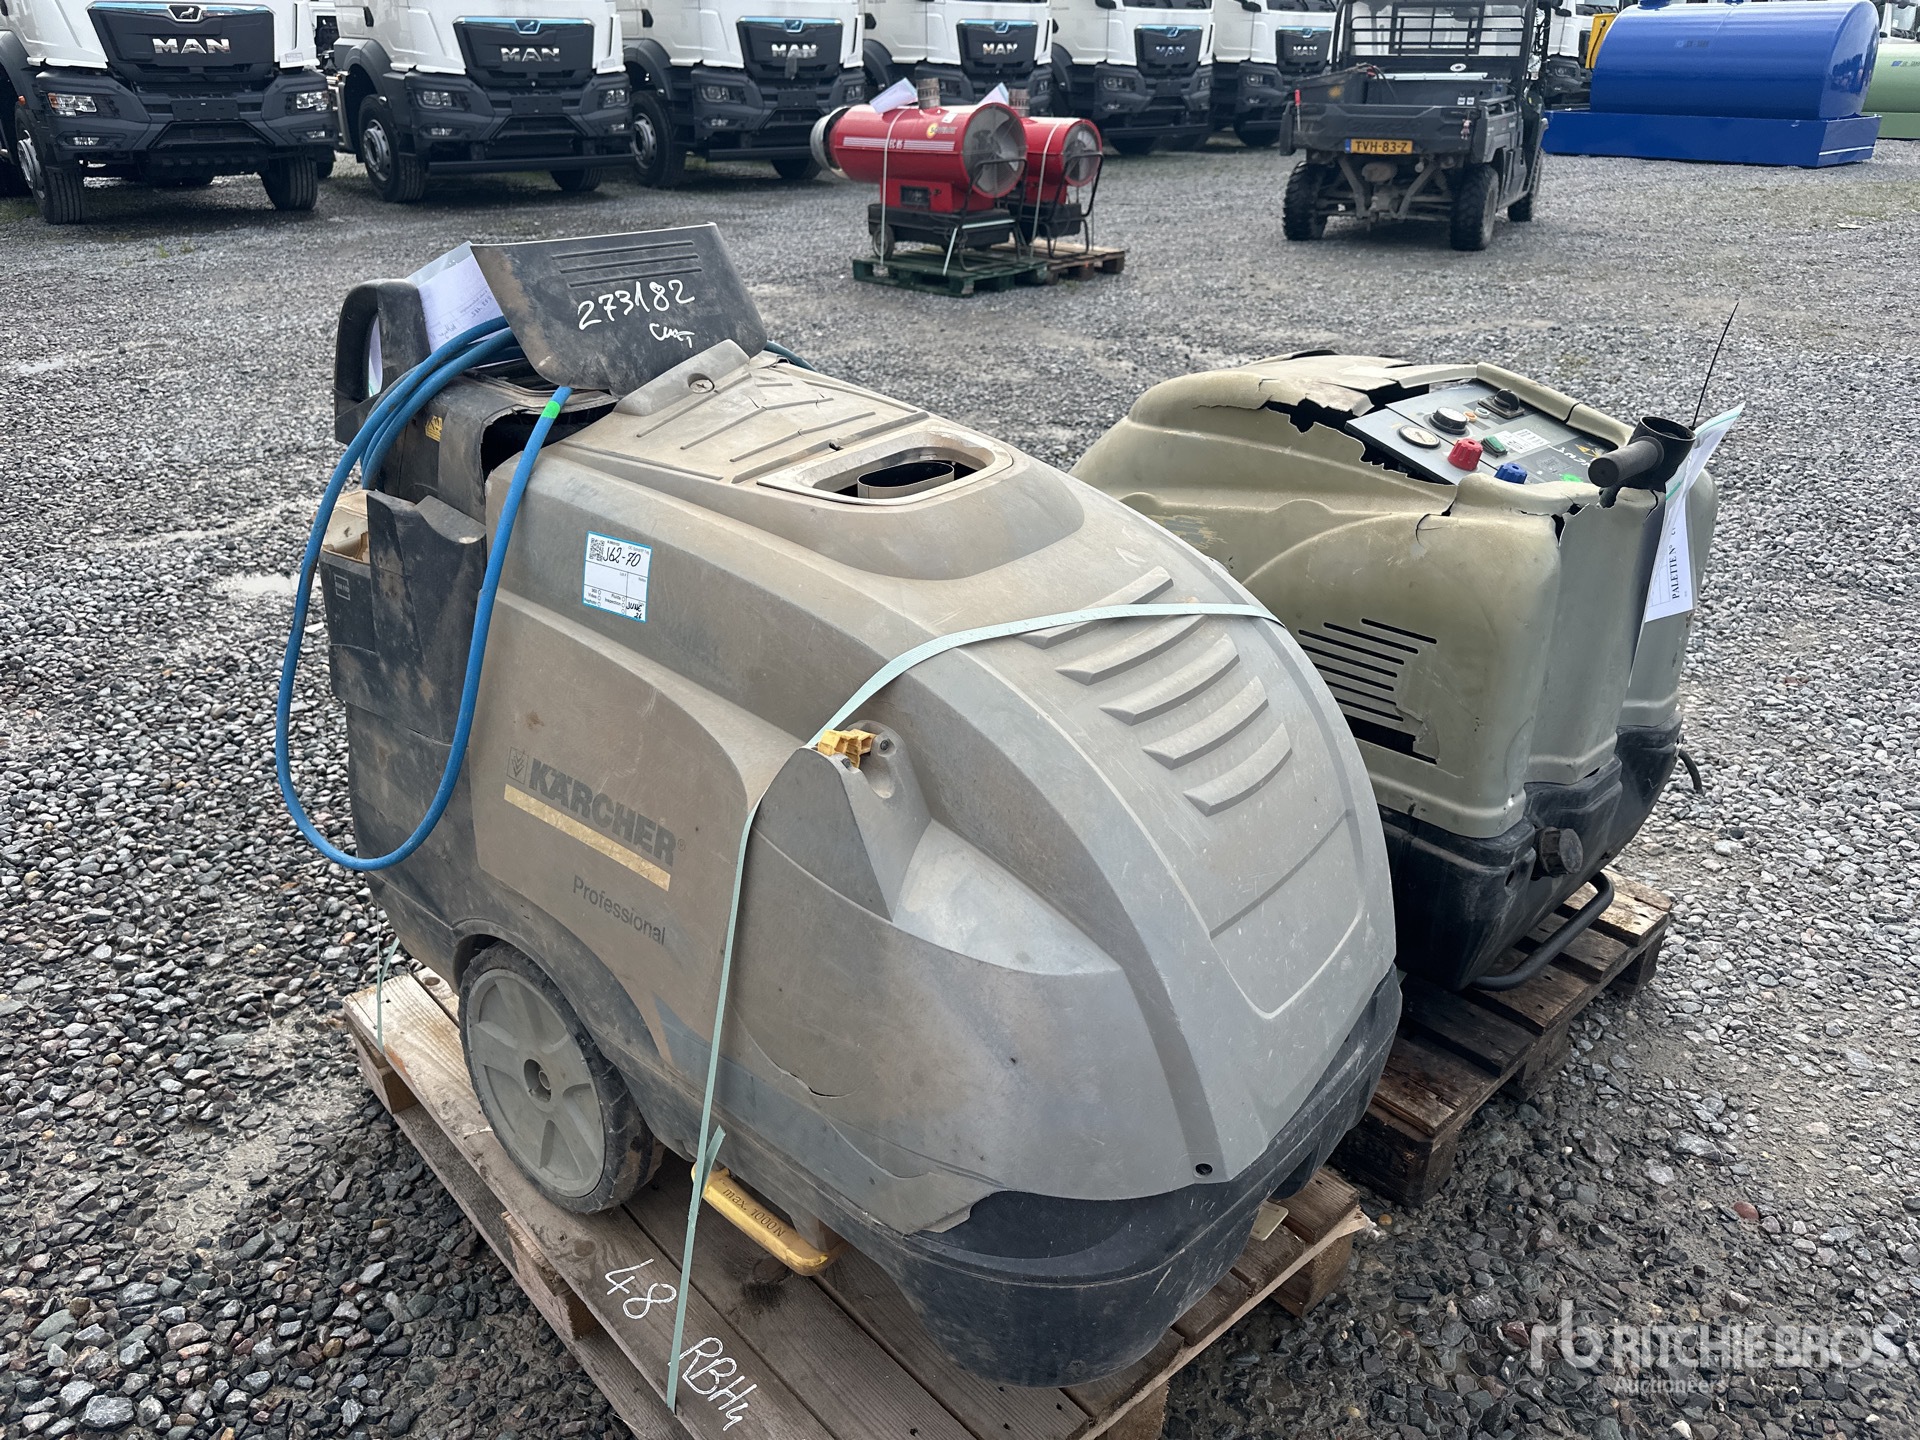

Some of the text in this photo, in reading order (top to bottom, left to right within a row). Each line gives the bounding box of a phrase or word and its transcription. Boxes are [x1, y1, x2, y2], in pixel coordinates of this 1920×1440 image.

[152, 38, 231, 54] MAN
[771, 44, 817, 58] MAN
[982, 43, 1018, 55] MAN
[500, 47, 560, 62] MAN
[1355, 141, 1408, 154] TVH-83-Z
[576, 279, 695, 331] 273182
[1668, 555, 1680, 600] PALETTE
[573, 873, 667, 946] Professional
[723, 1188, 747, 1210] max.
